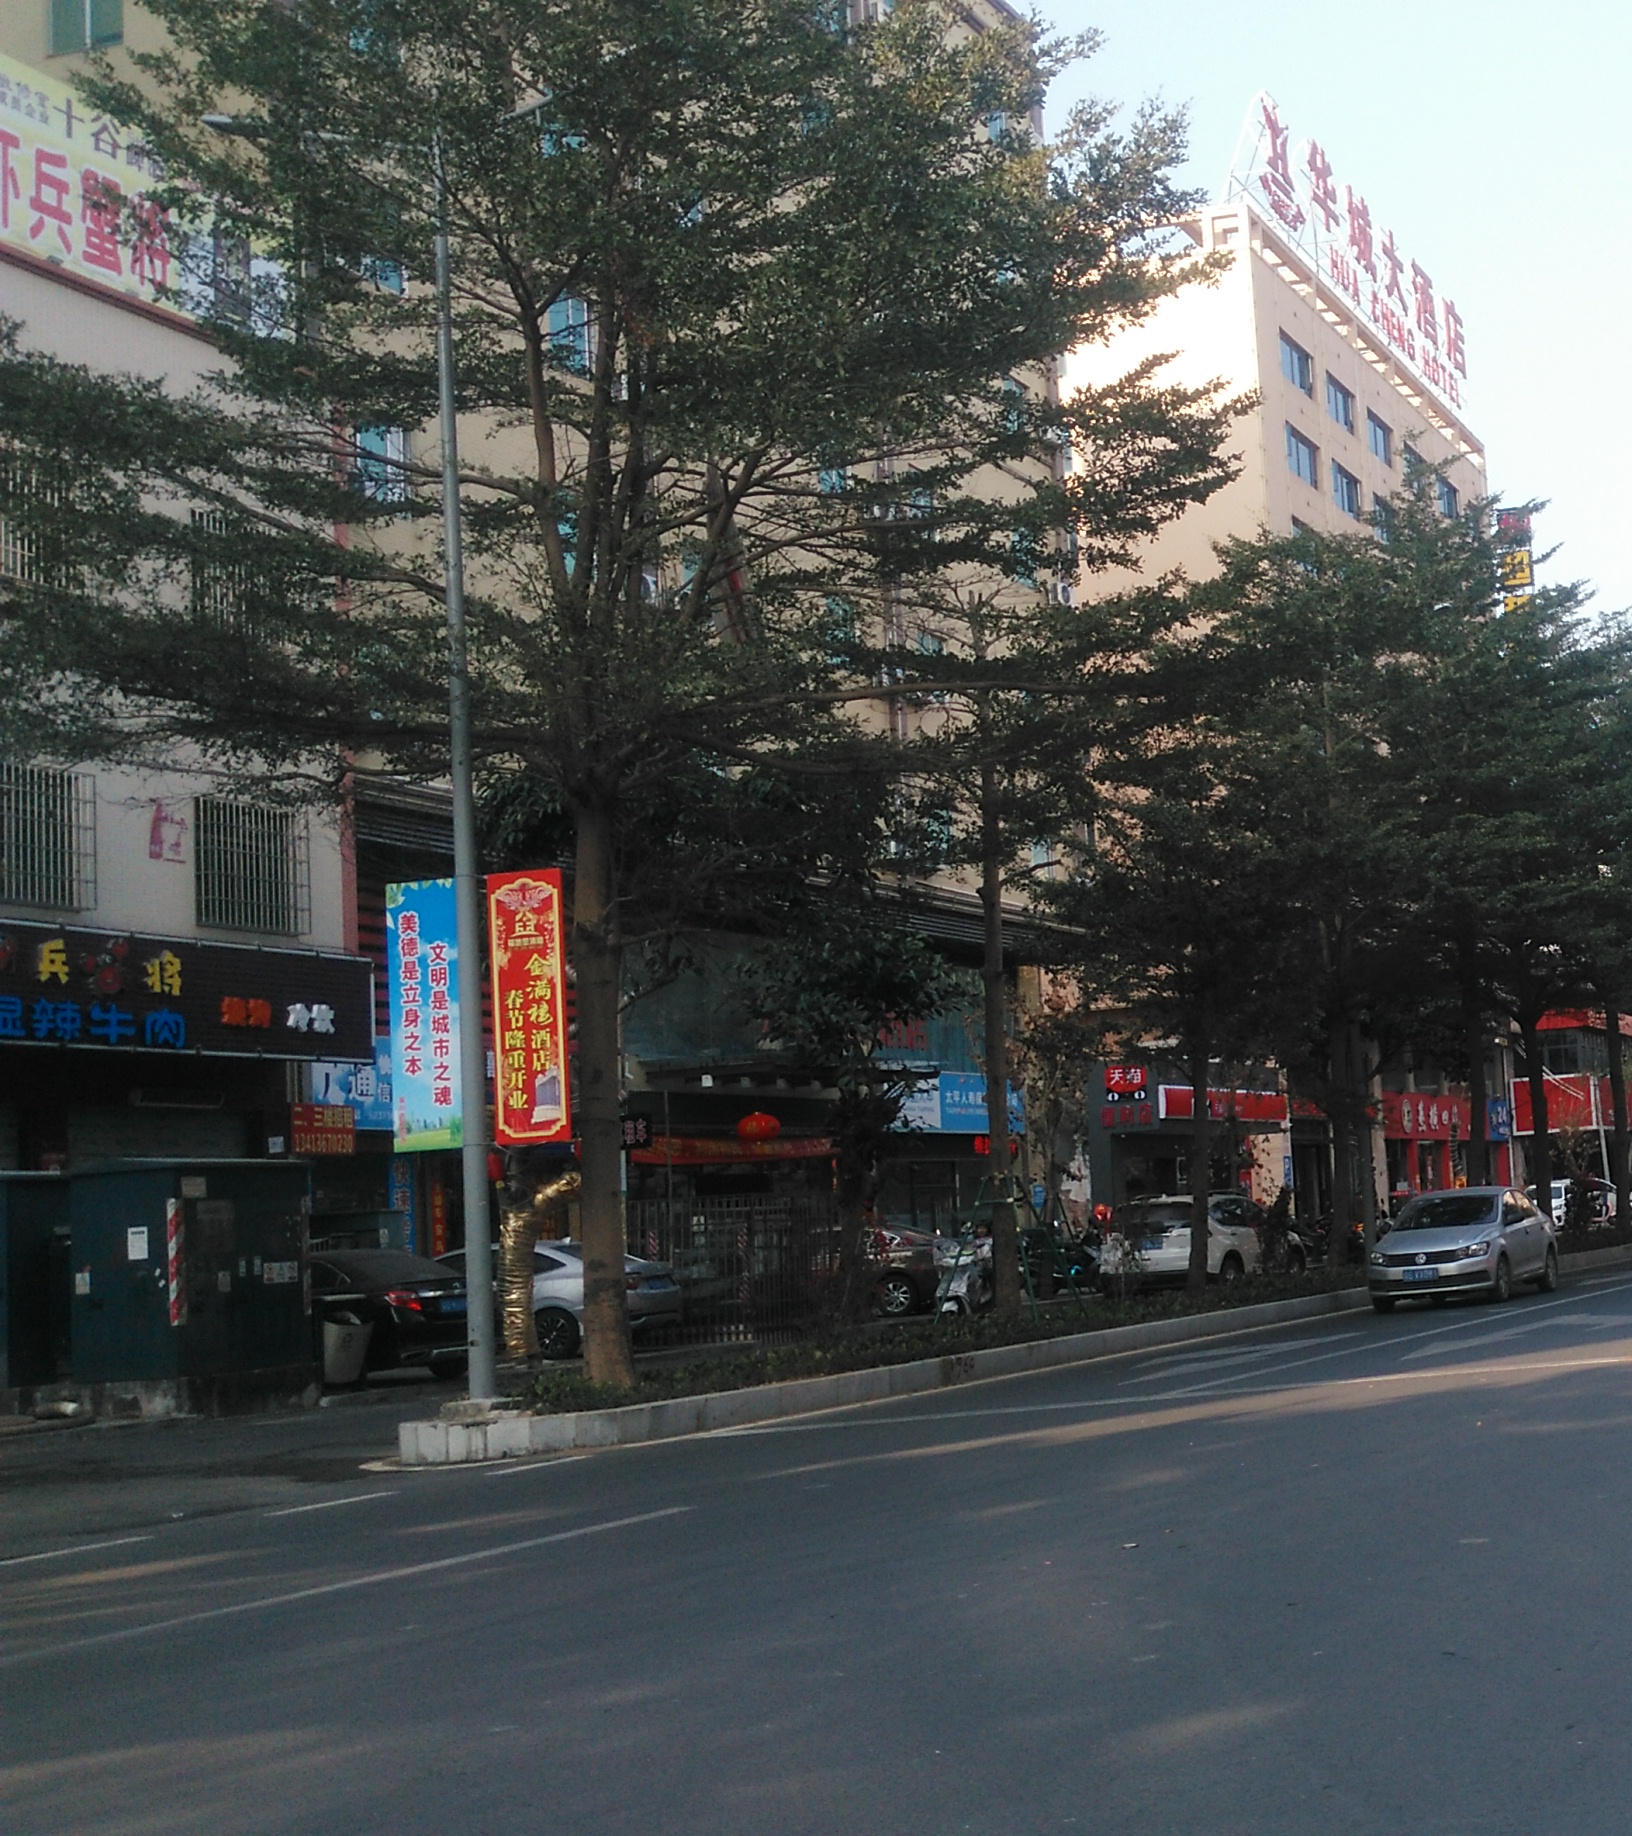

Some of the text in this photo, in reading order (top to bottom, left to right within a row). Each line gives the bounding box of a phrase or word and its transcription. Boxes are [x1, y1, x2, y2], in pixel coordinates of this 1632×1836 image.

[1307, 138, 1467, 380] 华城大酒店
[398, 910, 423, 1077] 美德是立身之本
[429, 942, 452, 1106] 文明是城市之魂
[504, 988, 528, 1110] 春节隆重开业
[1101, 1103, 1153, 1129] 便利店
[1109, 1068, 1142, 1085] 天猫
